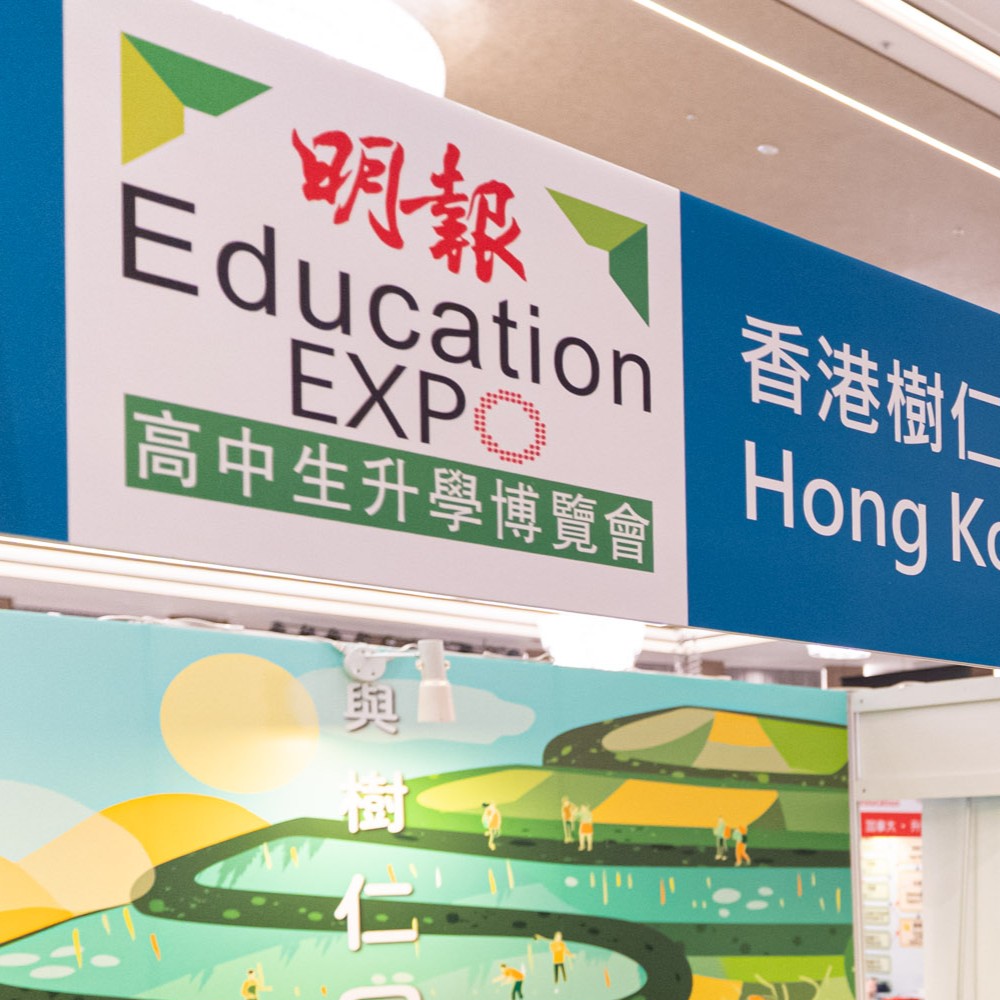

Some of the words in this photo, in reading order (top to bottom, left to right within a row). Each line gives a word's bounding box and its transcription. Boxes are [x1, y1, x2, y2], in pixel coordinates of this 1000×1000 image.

[291, 127, 527, 284] 明報
[121, 181, 653, 414] Education
[290, 337, 547, 466] EXPO
[133, 410, 651, 566] 高中生升學博覽會
[743, 439, 927, 576] Hong
